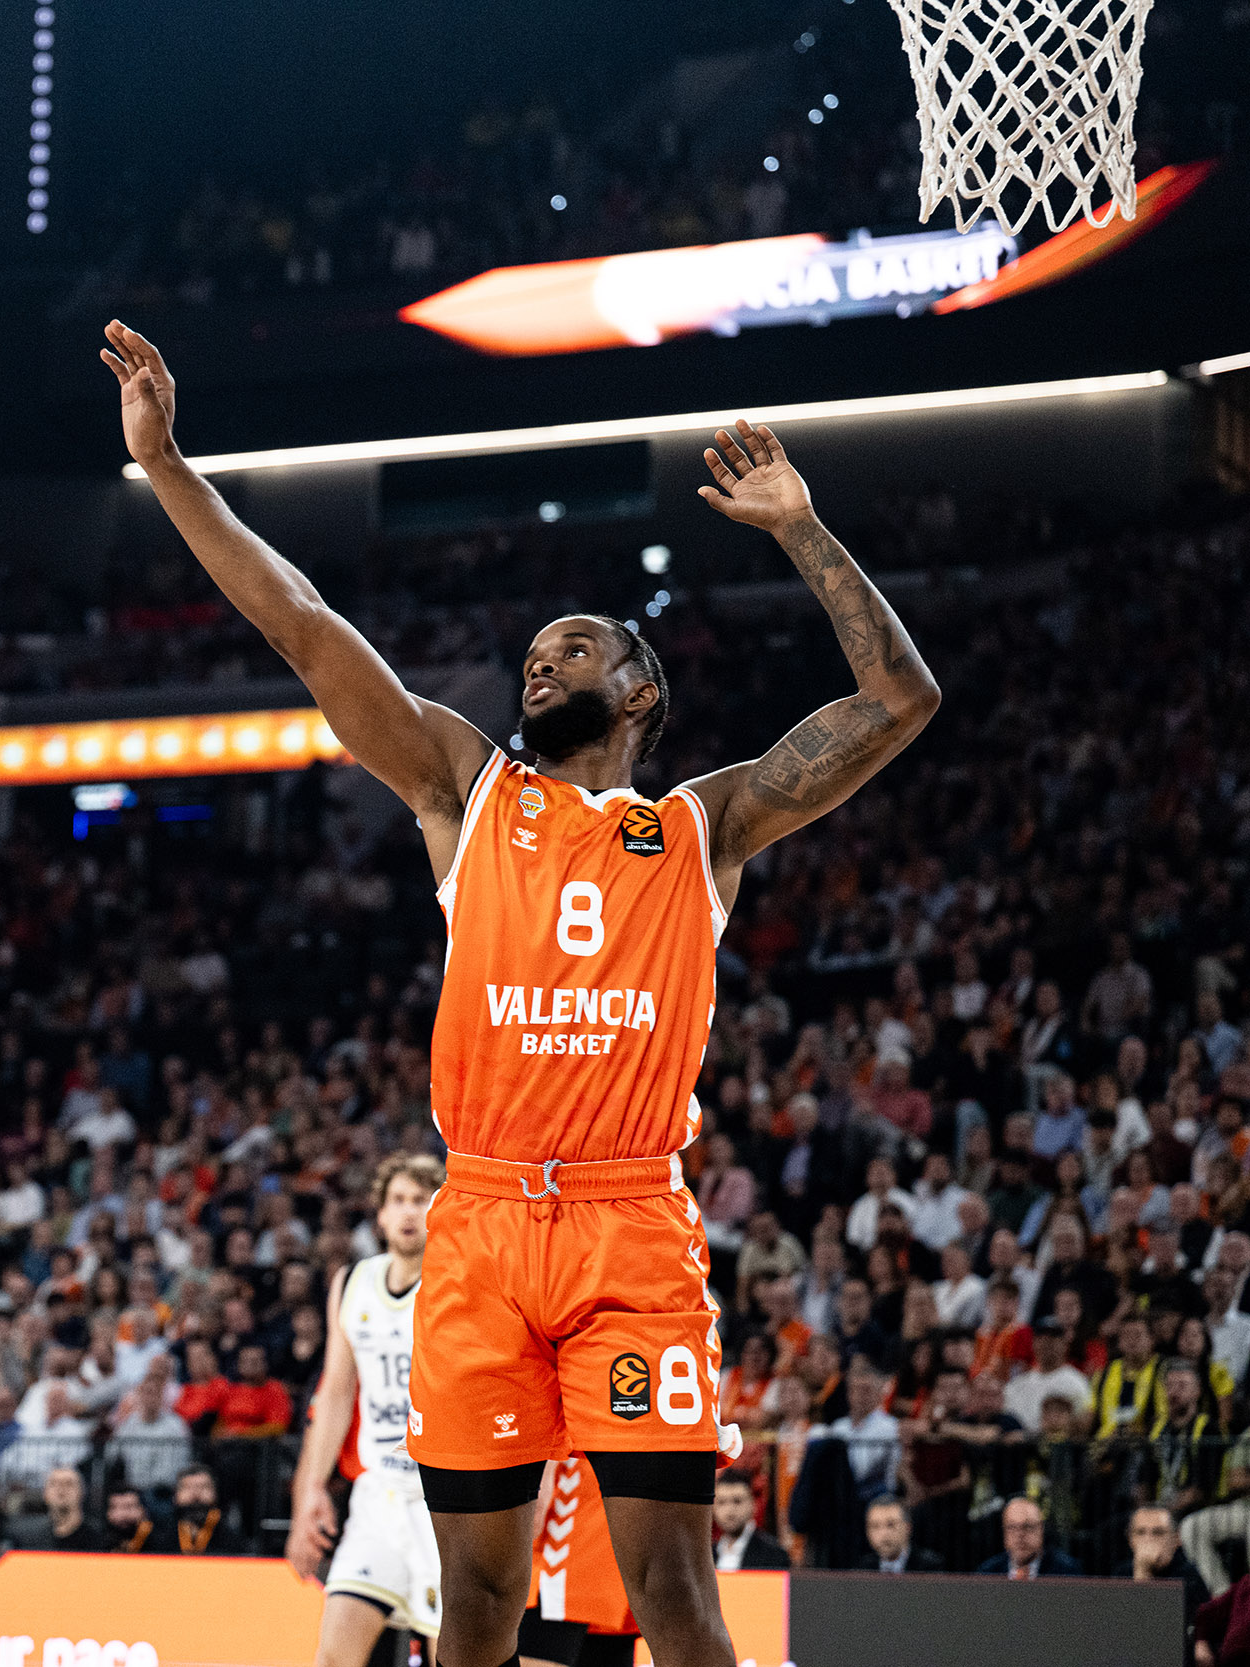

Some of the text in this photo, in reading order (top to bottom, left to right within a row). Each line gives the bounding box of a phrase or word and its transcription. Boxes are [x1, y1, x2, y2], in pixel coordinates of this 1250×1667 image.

[557, 881, 604, 956] 8
[486, 984, 656, 1032] VALENCIA
[521, 1033, 616, 1056] BASKET
[657, 1346, 703, 1425] 8
[43, 1637, 159, 1667] pace
